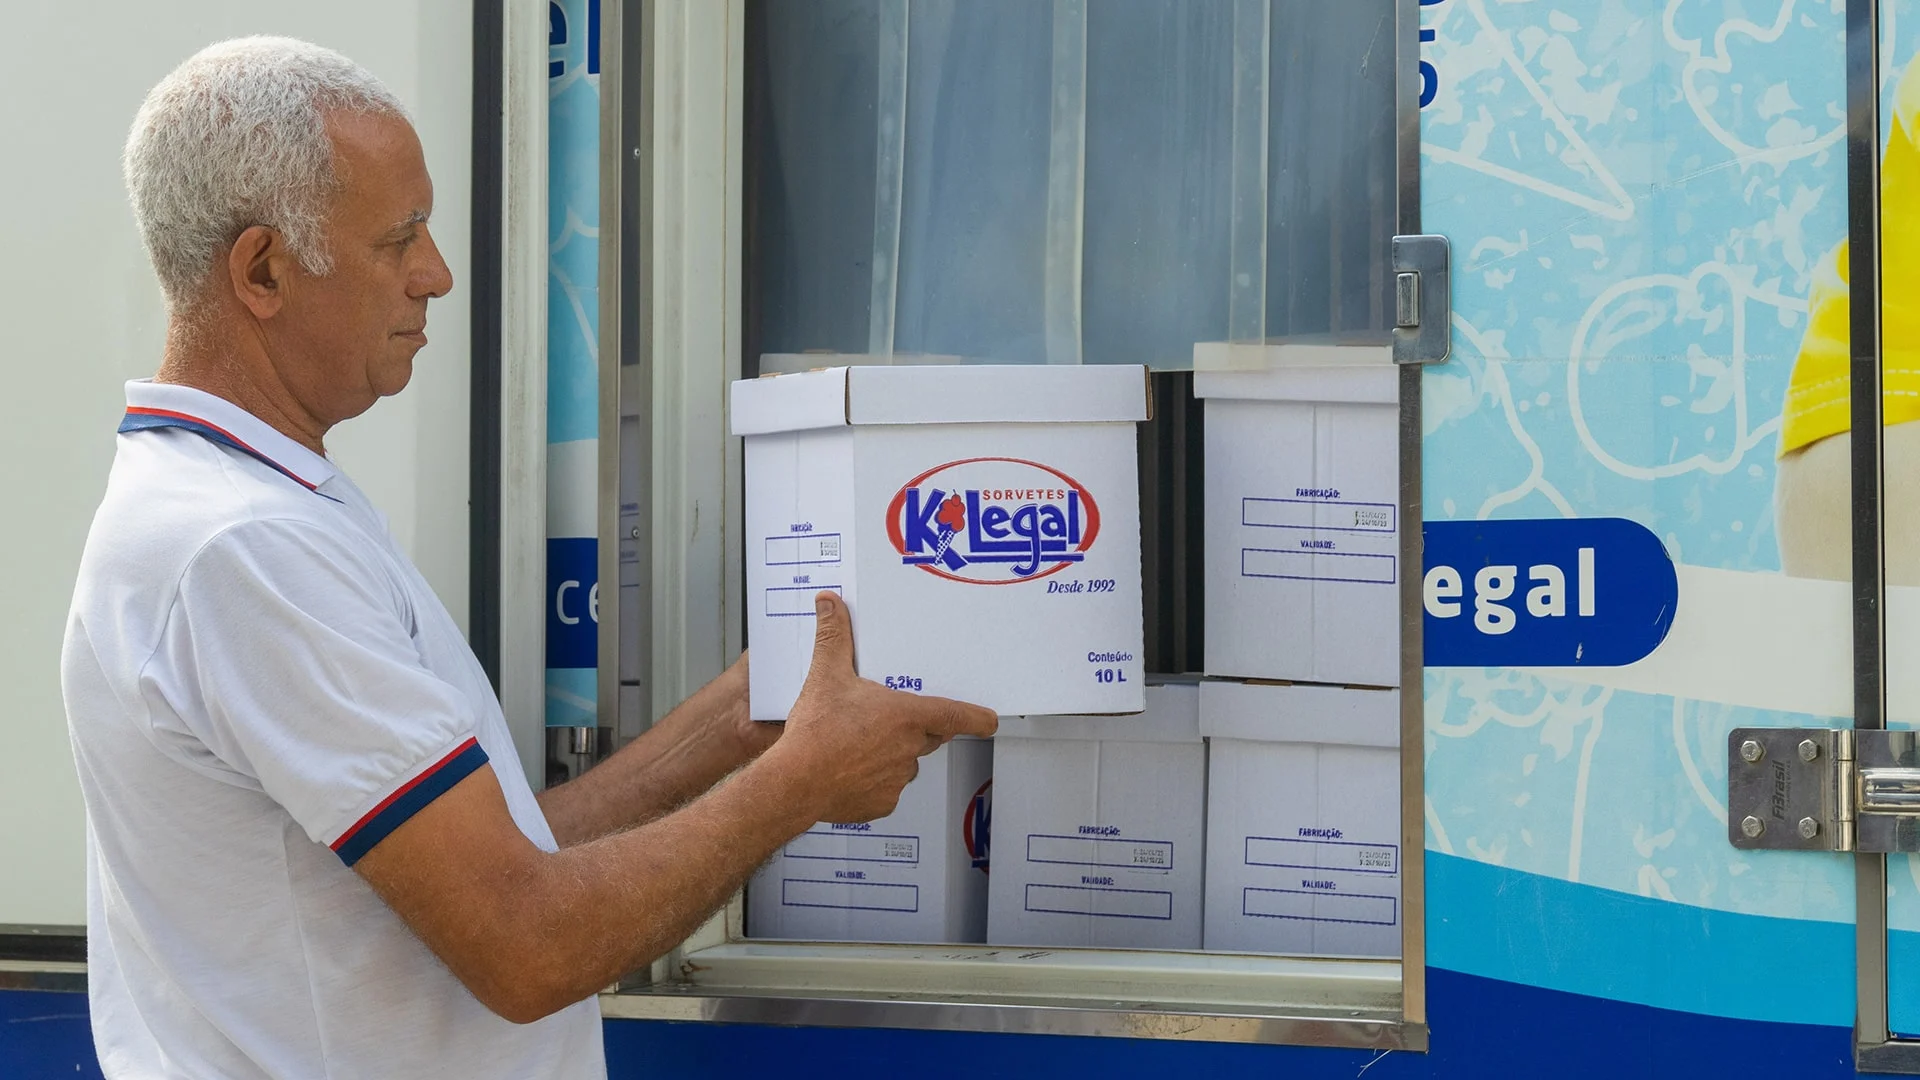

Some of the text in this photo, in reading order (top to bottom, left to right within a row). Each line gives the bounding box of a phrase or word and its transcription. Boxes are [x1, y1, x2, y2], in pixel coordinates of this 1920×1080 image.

[983, 489, 1064, 500] SORVETES
[1047, 579, 1115, 593] Desde 1992
[1088, 651, 1132, 662] Conteúdo
[1095, 669, 1127, 682] 10 L
